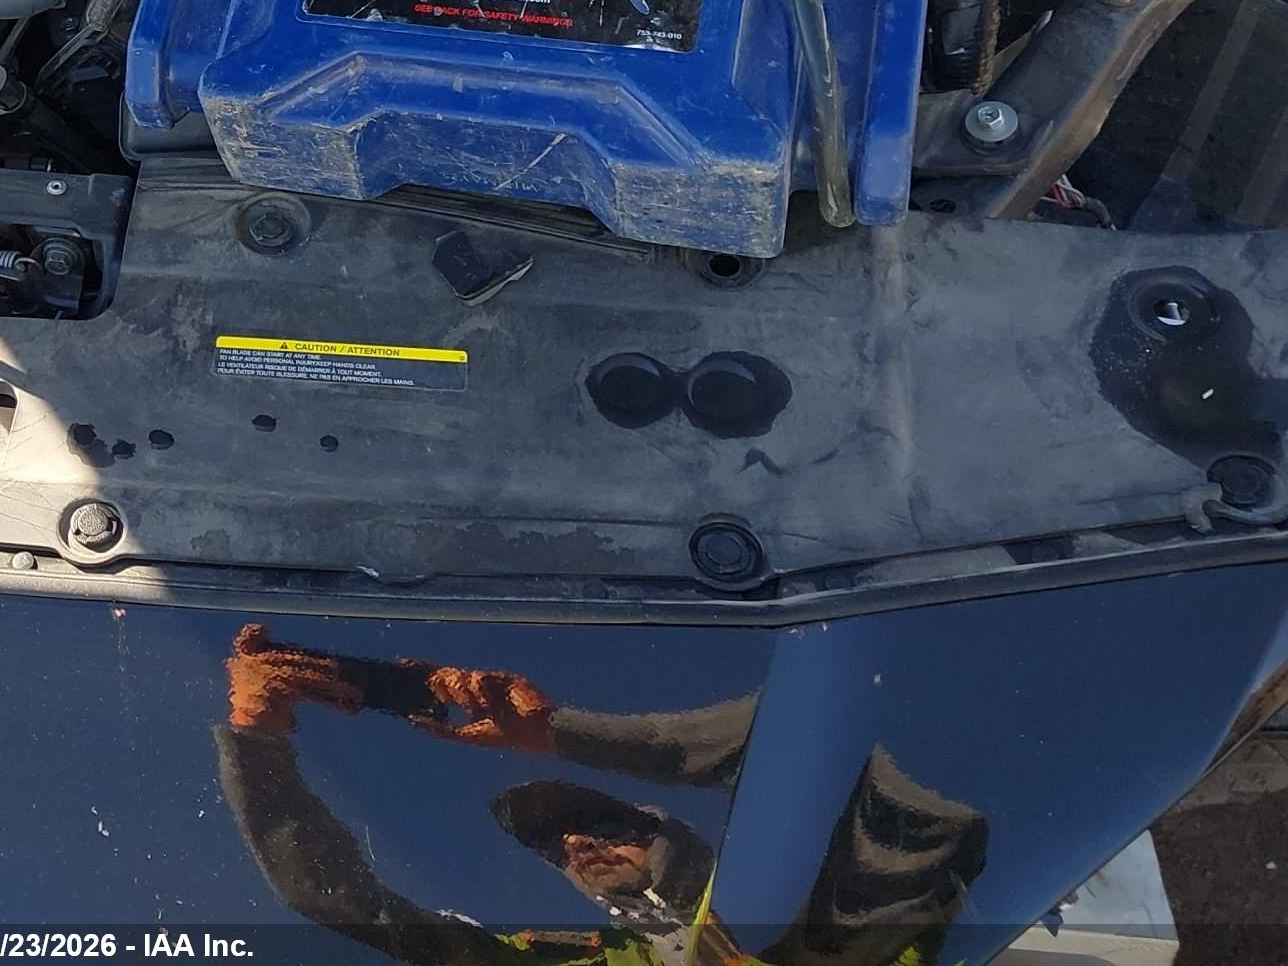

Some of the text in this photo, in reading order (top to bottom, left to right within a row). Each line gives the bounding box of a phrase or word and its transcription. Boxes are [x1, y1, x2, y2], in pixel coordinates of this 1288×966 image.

[414, 4, 435, 13] SEE
[462, 8, 484, 17] FOR
[484, 10, 521, 21] SAFETY
[522, 15, 574, 27] WARNINGS
[295, 343, 337, 352] CAUTION
[347, 346, 400, 356] ATTENTION
[342, 376, 380, 384] APPROCHER
